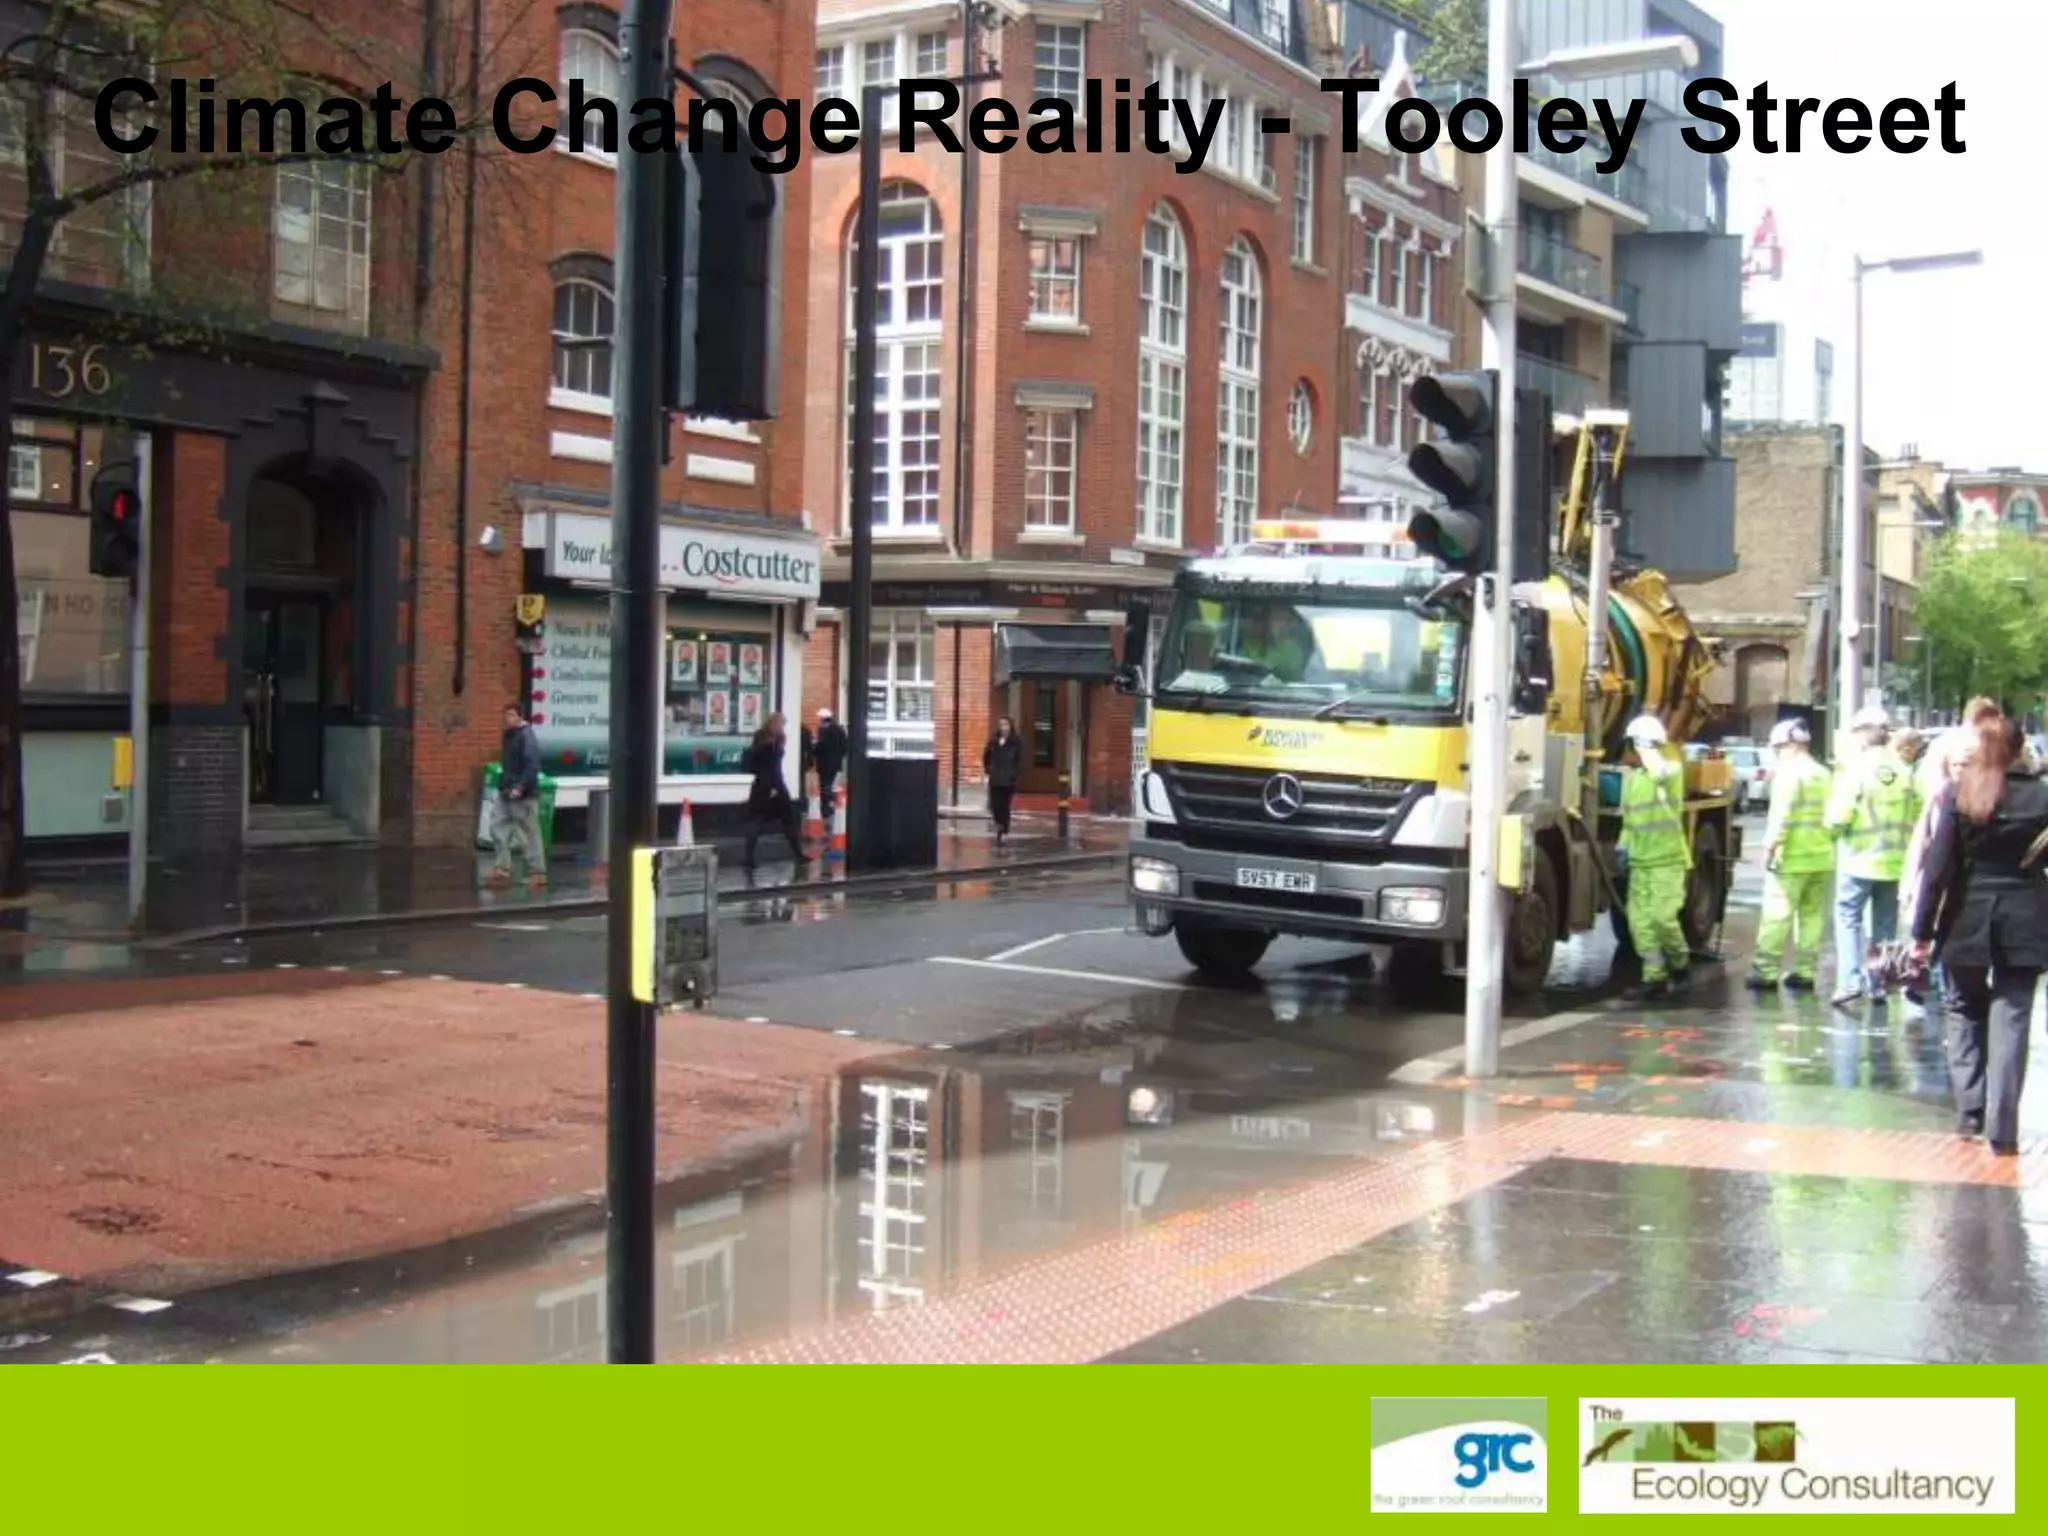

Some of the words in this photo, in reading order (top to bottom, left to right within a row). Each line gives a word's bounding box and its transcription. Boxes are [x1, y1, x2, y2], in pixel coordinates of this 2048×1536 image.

[32, 343, 109, 397] 136
[563, 540, 596, 563] Your
[683, 541, 814, 584] Costcutter
